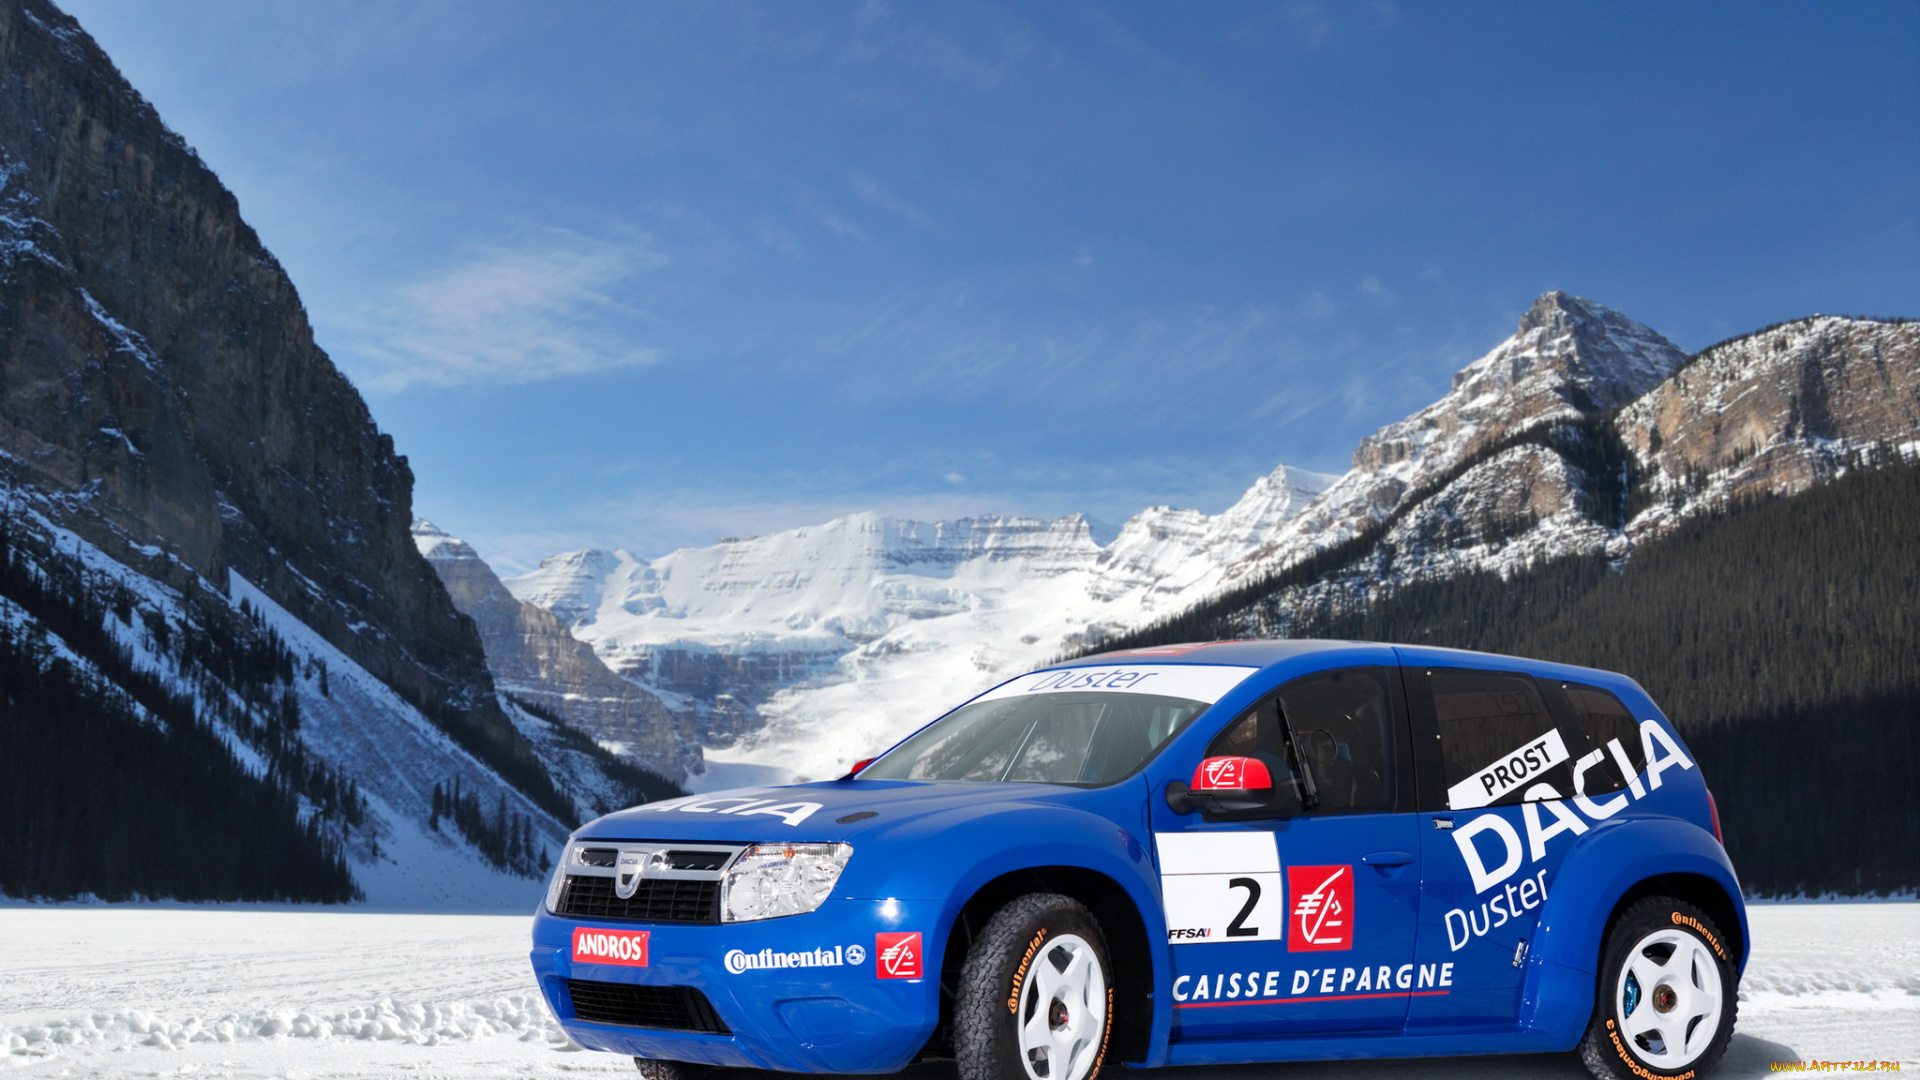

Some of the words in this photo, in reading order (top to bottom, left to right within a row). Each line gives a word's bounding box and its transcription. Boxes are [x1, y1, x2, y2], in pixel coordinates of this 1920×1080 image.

[1028, 669, 1158, 692] Duster
[1480, 740, 1552, 797] PROST
[1452, 719, 1694, 895] DACIA
[1226, 877, 1262, 938] 2
[1444, 868, 1548, 952] Duster
[577, 933, 643, 961] ANDROS
[1168, 928, 1206, 939] FFSA
[724, 945, 844, 974] Continental
[1172, 971, 1281, 1002] CAISSE
[1291, 962, 1454, 996] D'EPARGNE
[1606, 1019, 1615, 1030] 3
